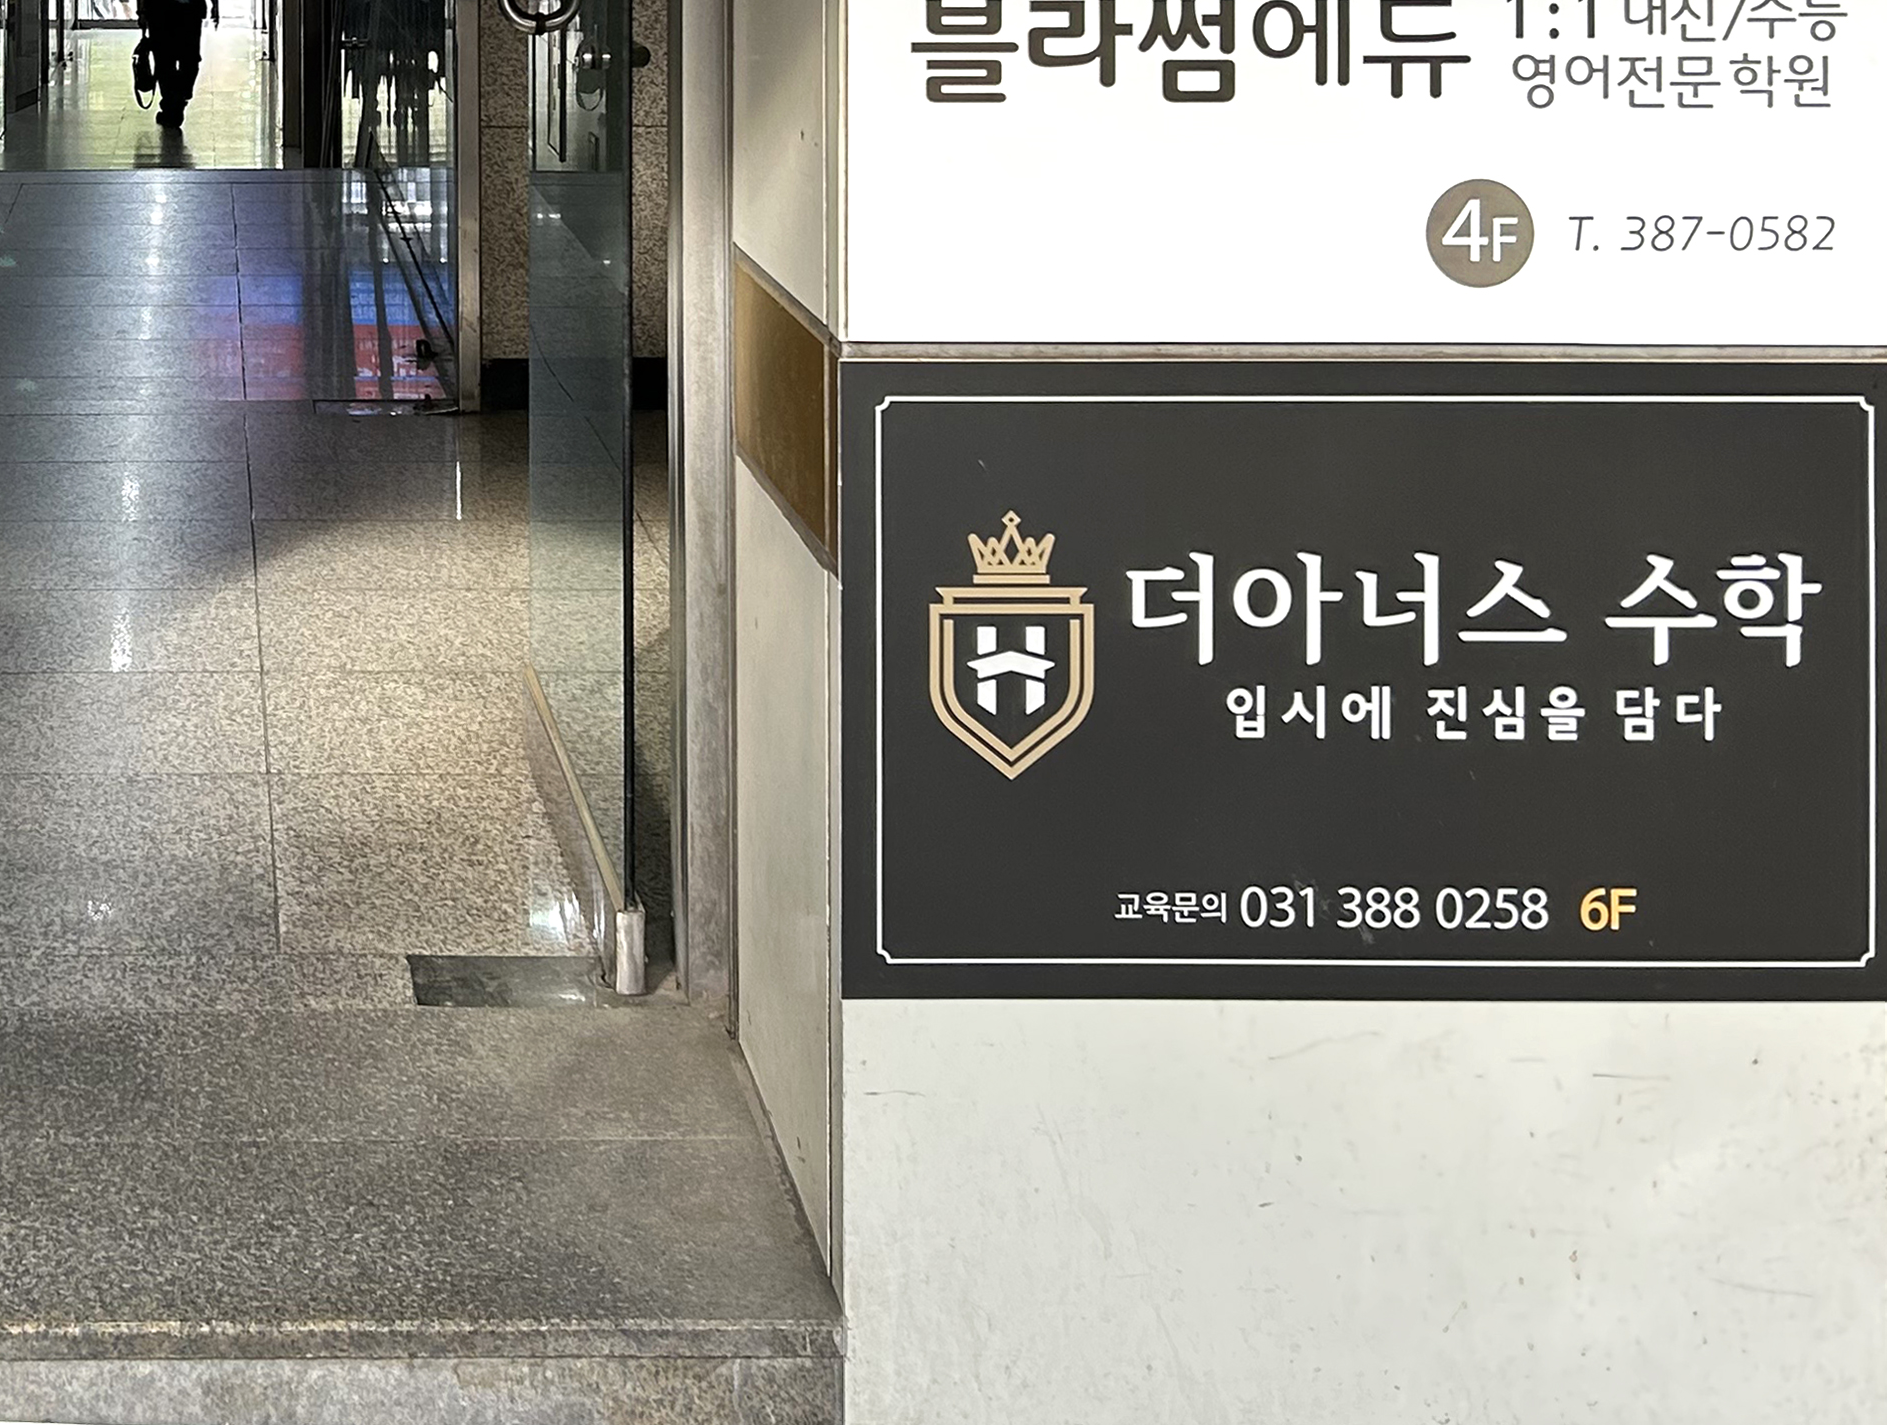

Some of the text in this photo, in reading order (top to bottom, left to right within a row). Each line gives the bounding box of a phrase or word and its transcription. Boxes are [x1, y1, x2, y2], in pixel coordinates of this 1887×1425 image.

[1442, 198, 1519, 262] 4F
[1620, 215, 1835, 251] 387-0582
[1125, 549, 1822, 668] 더아너스 수학
[1226, 685, 1724, 743] 입시에 진심을 담다
[1114, 886, 1638, 931] 교육문의 031 388 0258 6F
